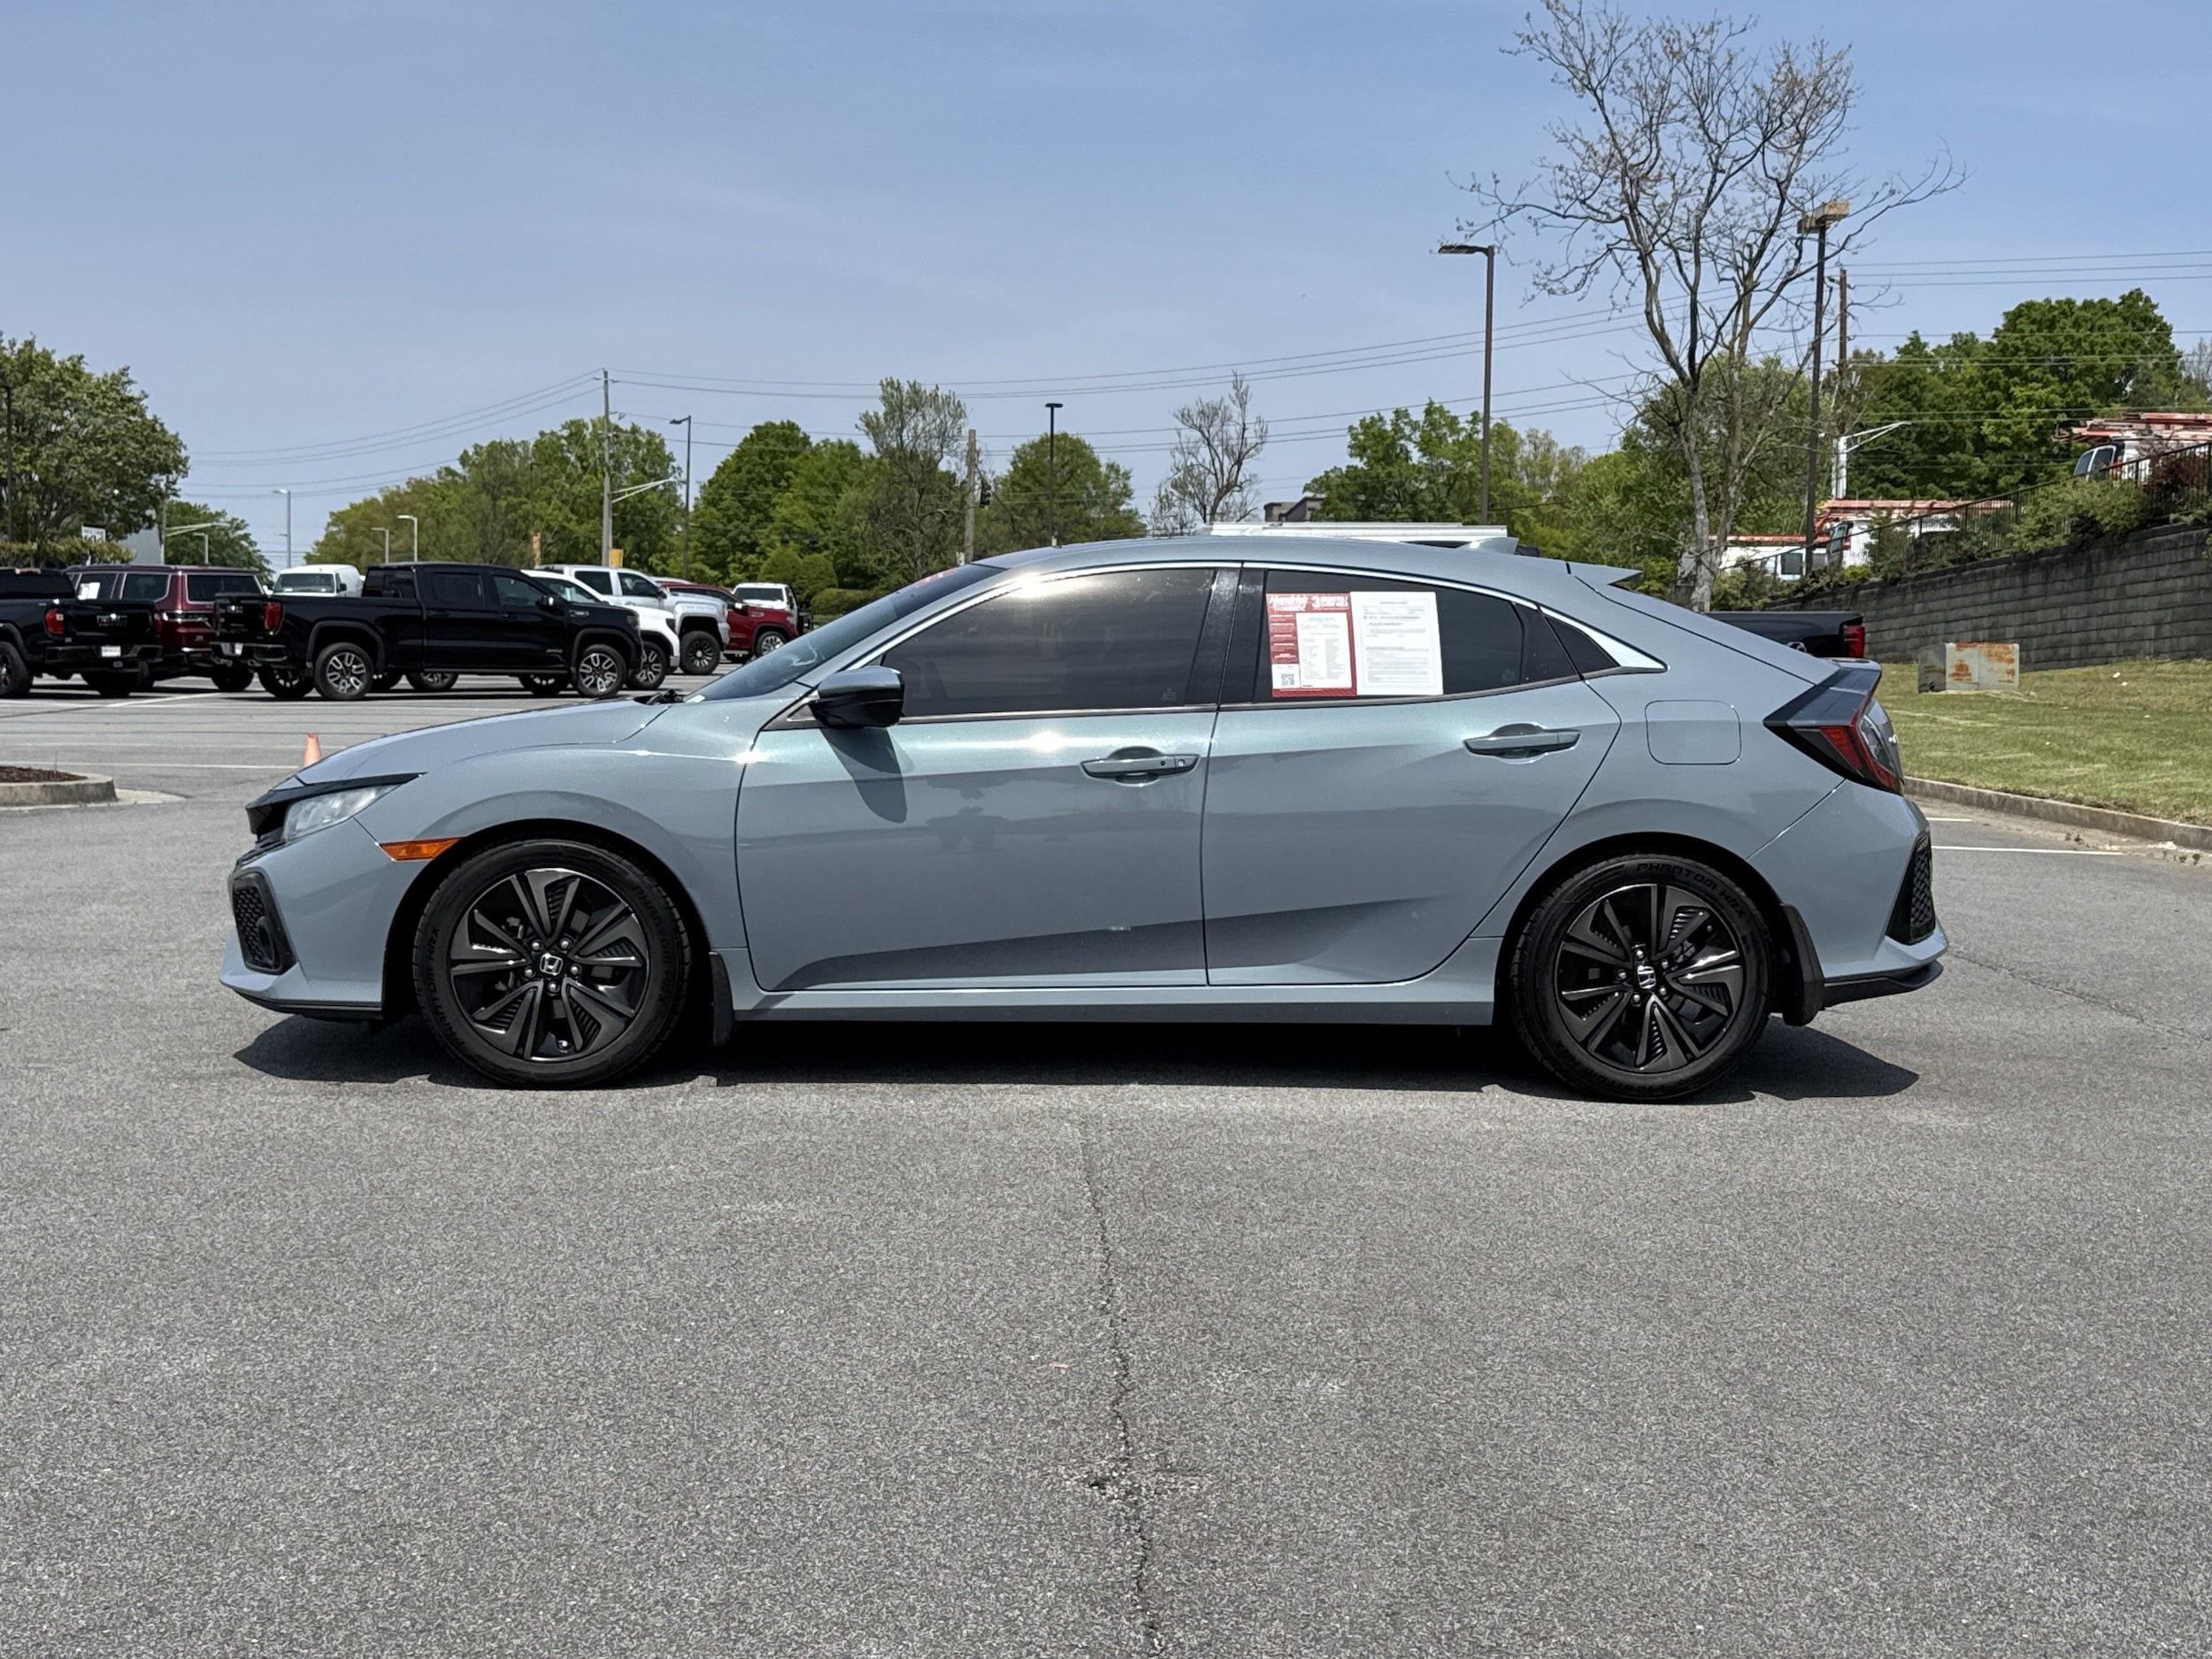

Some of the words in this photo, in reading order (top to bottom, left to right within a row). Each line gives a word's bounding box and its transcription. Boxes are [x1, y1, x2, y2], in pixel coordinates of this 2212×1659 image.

[1636, 863, 1718, 890] PHANTOM
[1719, 890, 1747, 918] HRX
[426, 926, 440, 962] HRX
[426, 967, 465, 1048] PHANTOM
